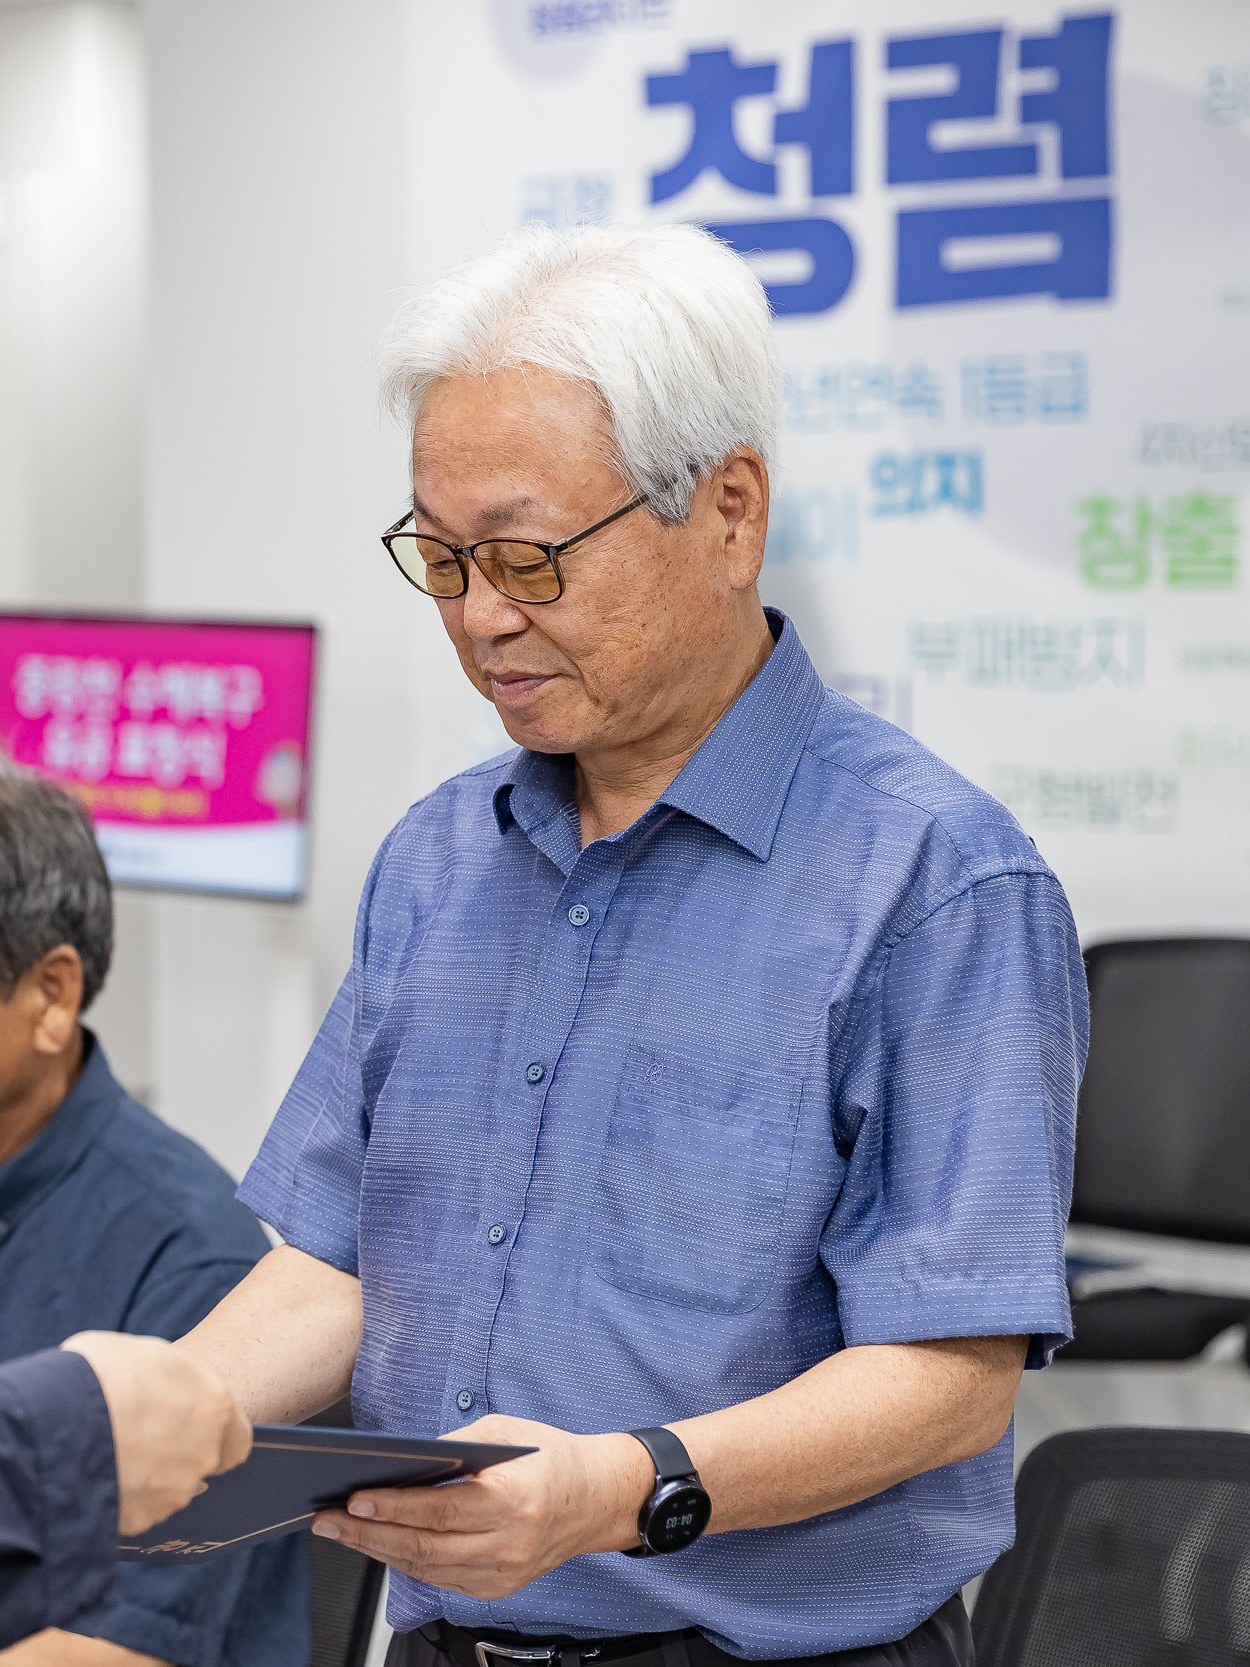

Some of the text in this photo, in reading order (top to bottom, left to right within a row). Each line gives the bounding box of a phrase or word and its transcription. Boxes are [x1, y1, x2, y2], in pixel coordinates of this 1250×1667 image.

[643, 10, 1114, 318] 청렴
[961, 351, 1090, 425] 1등급
[867, 447, 986, 519] 의지
[1077, 491, 1241, 592] 창출
[907, 617, 1147, 691] 부패방지
[666, 1513, 693, 1529] 04:03
